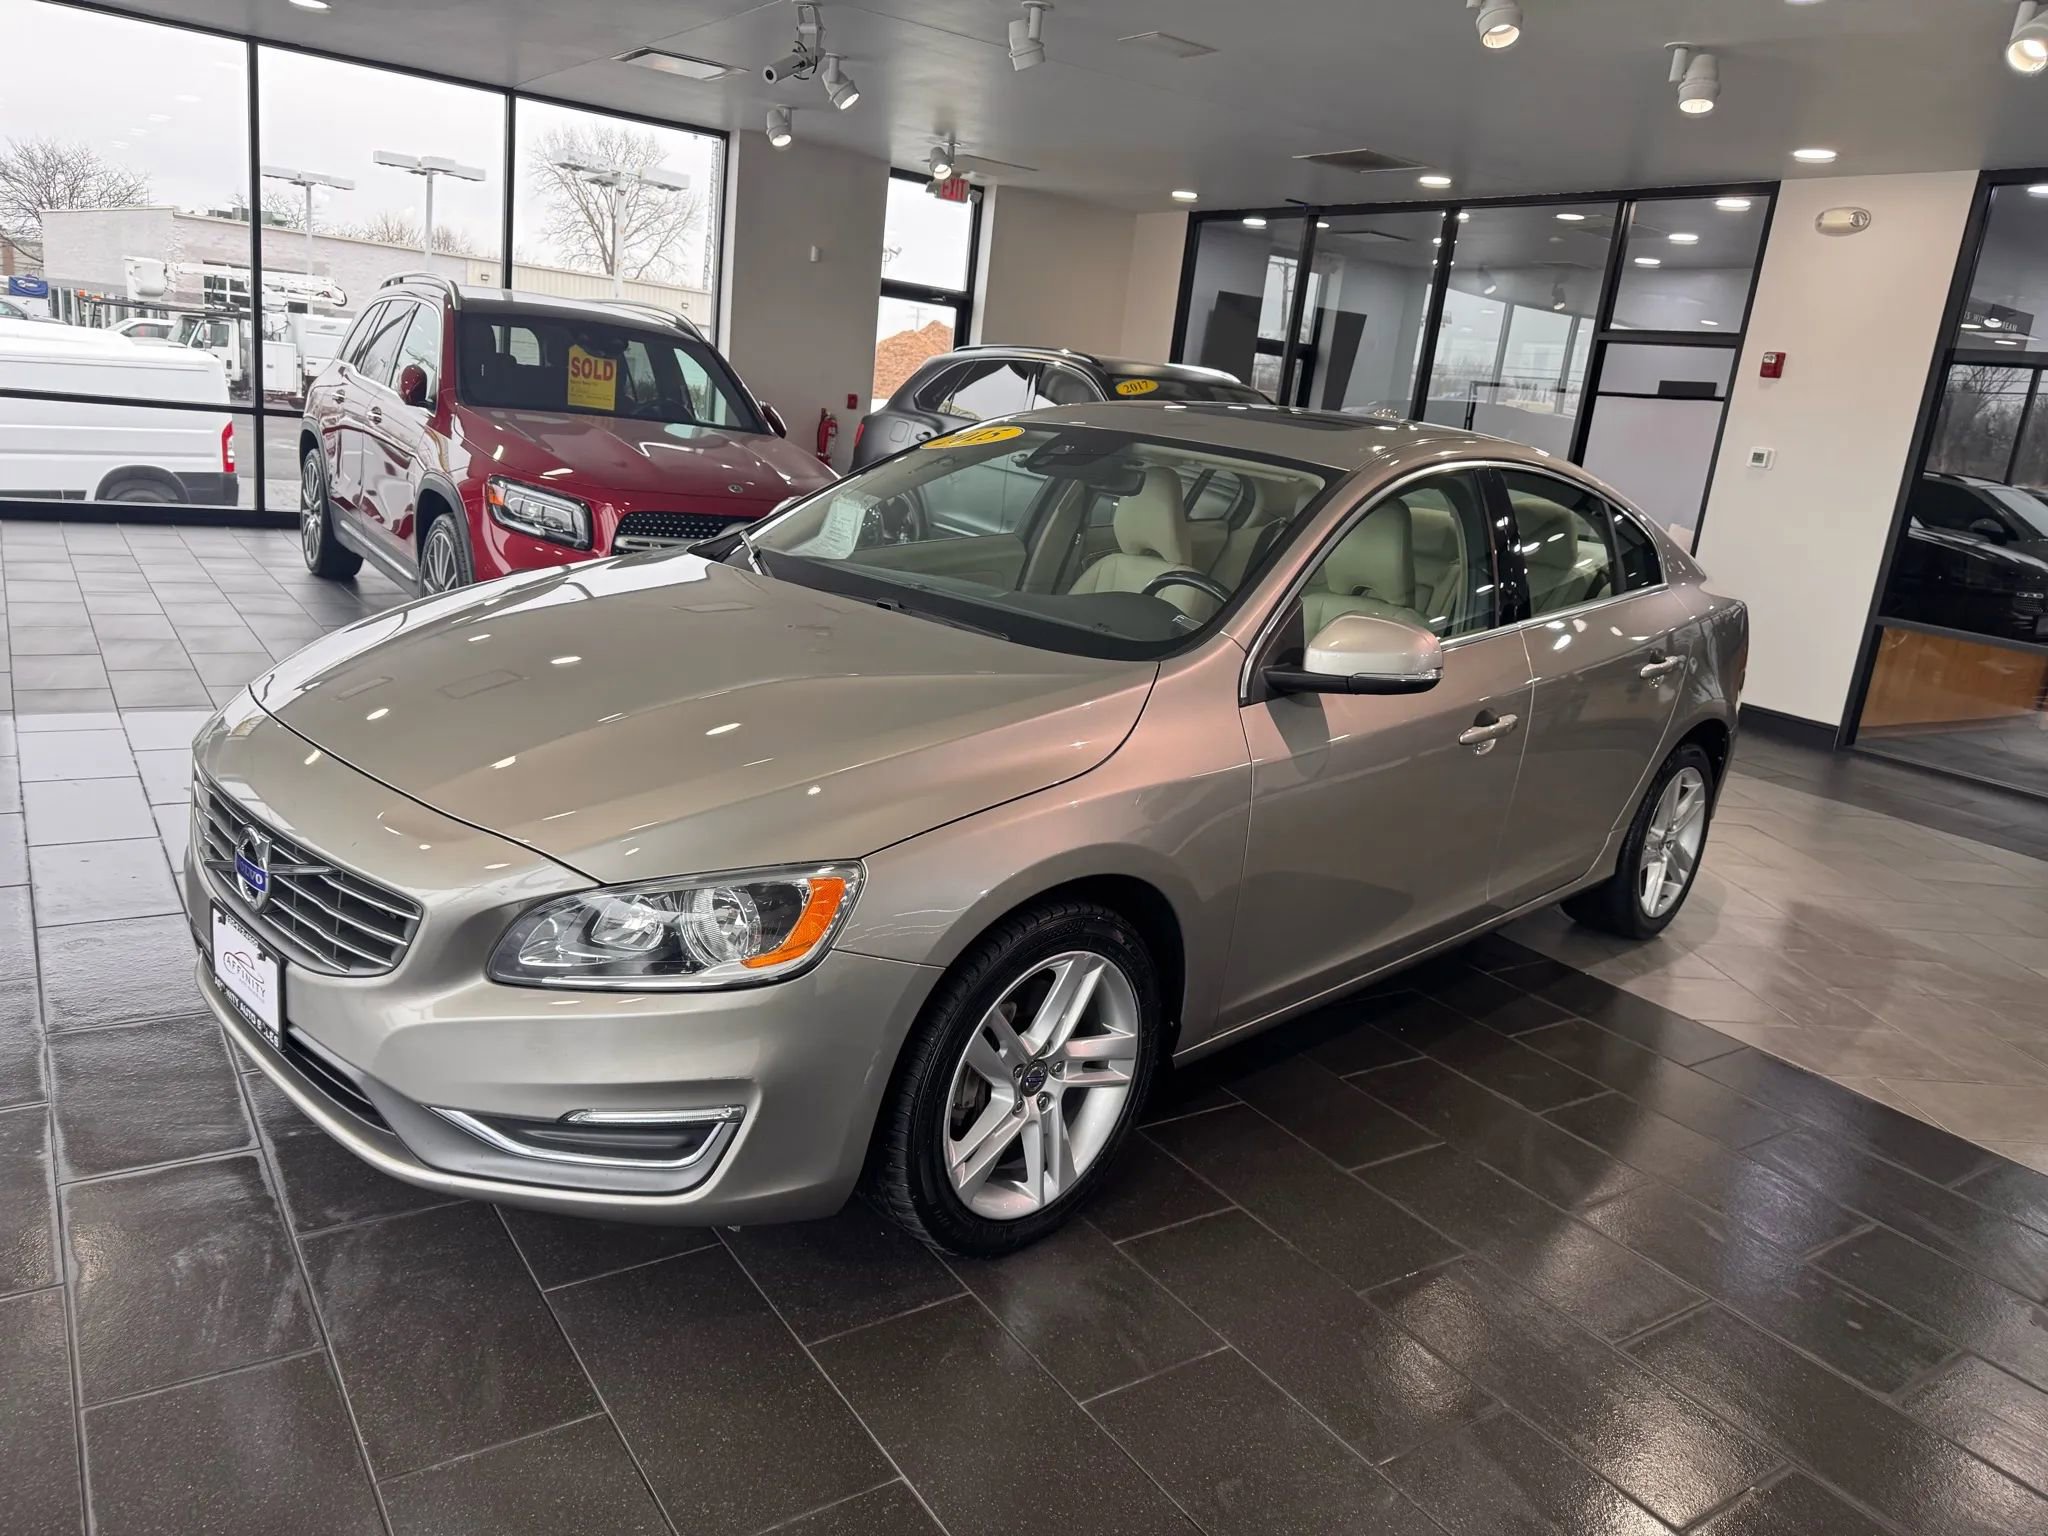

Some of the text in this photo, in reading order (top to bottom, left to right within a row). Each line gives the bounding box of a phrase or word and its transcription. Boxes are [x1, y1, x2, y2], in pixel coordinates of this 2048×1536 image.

[942, 178, 967, 201] EXIT
[571, 356, 614, 381] SOLD
[1123, 380, 1149, 393] 2017
[238, 858, 264, 885] OLVO
[226, 955, 266, 998] AFFINITY
[240, 1002, 257, 1025] AUTO
[257, 1018, 279, 1048] SLES
